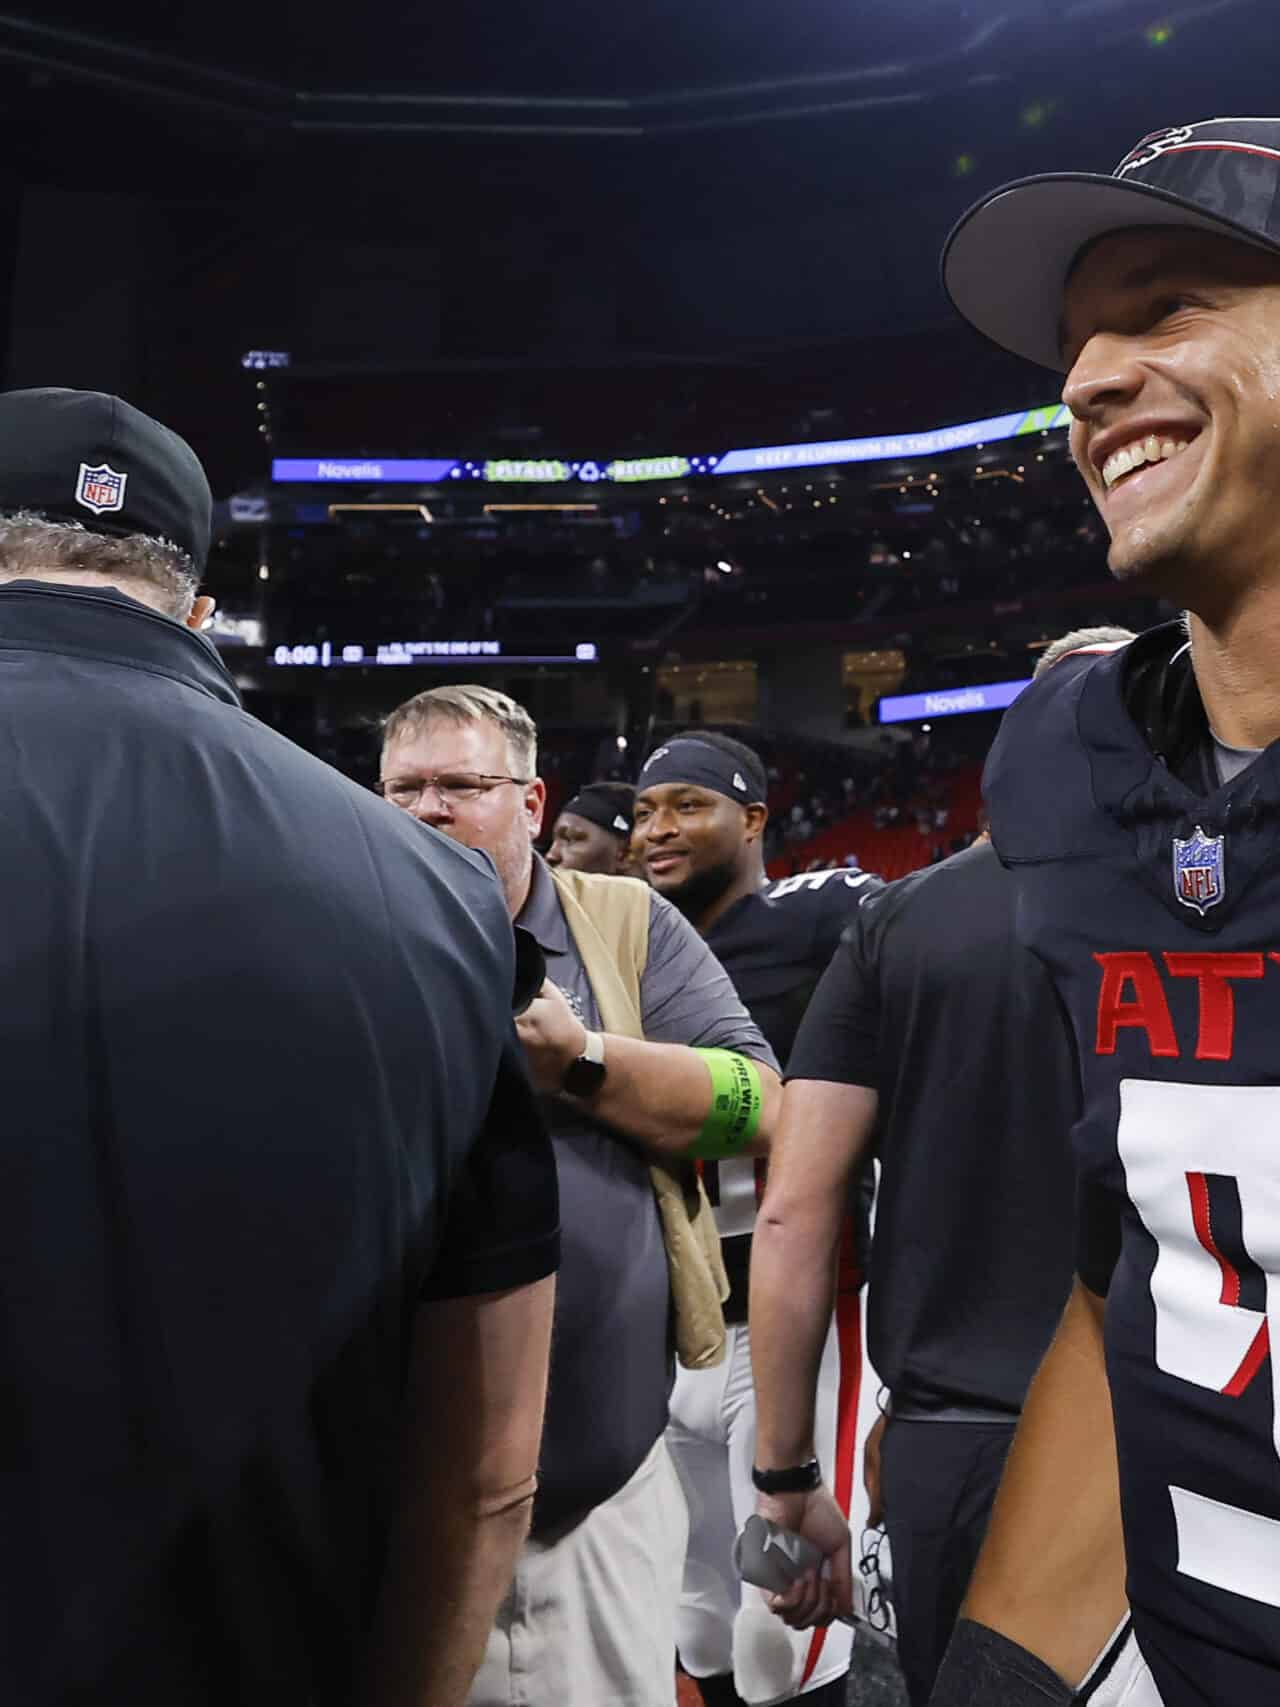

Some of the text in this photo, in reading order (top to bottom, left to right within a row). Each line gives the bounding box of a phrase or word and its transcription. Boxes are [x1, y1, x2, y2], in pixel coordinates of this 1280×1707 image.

[319, 462, 383, 479] Novelis
[86, 483, 113, 503] NFL
[1183, 868, 1216, 897] NFL
